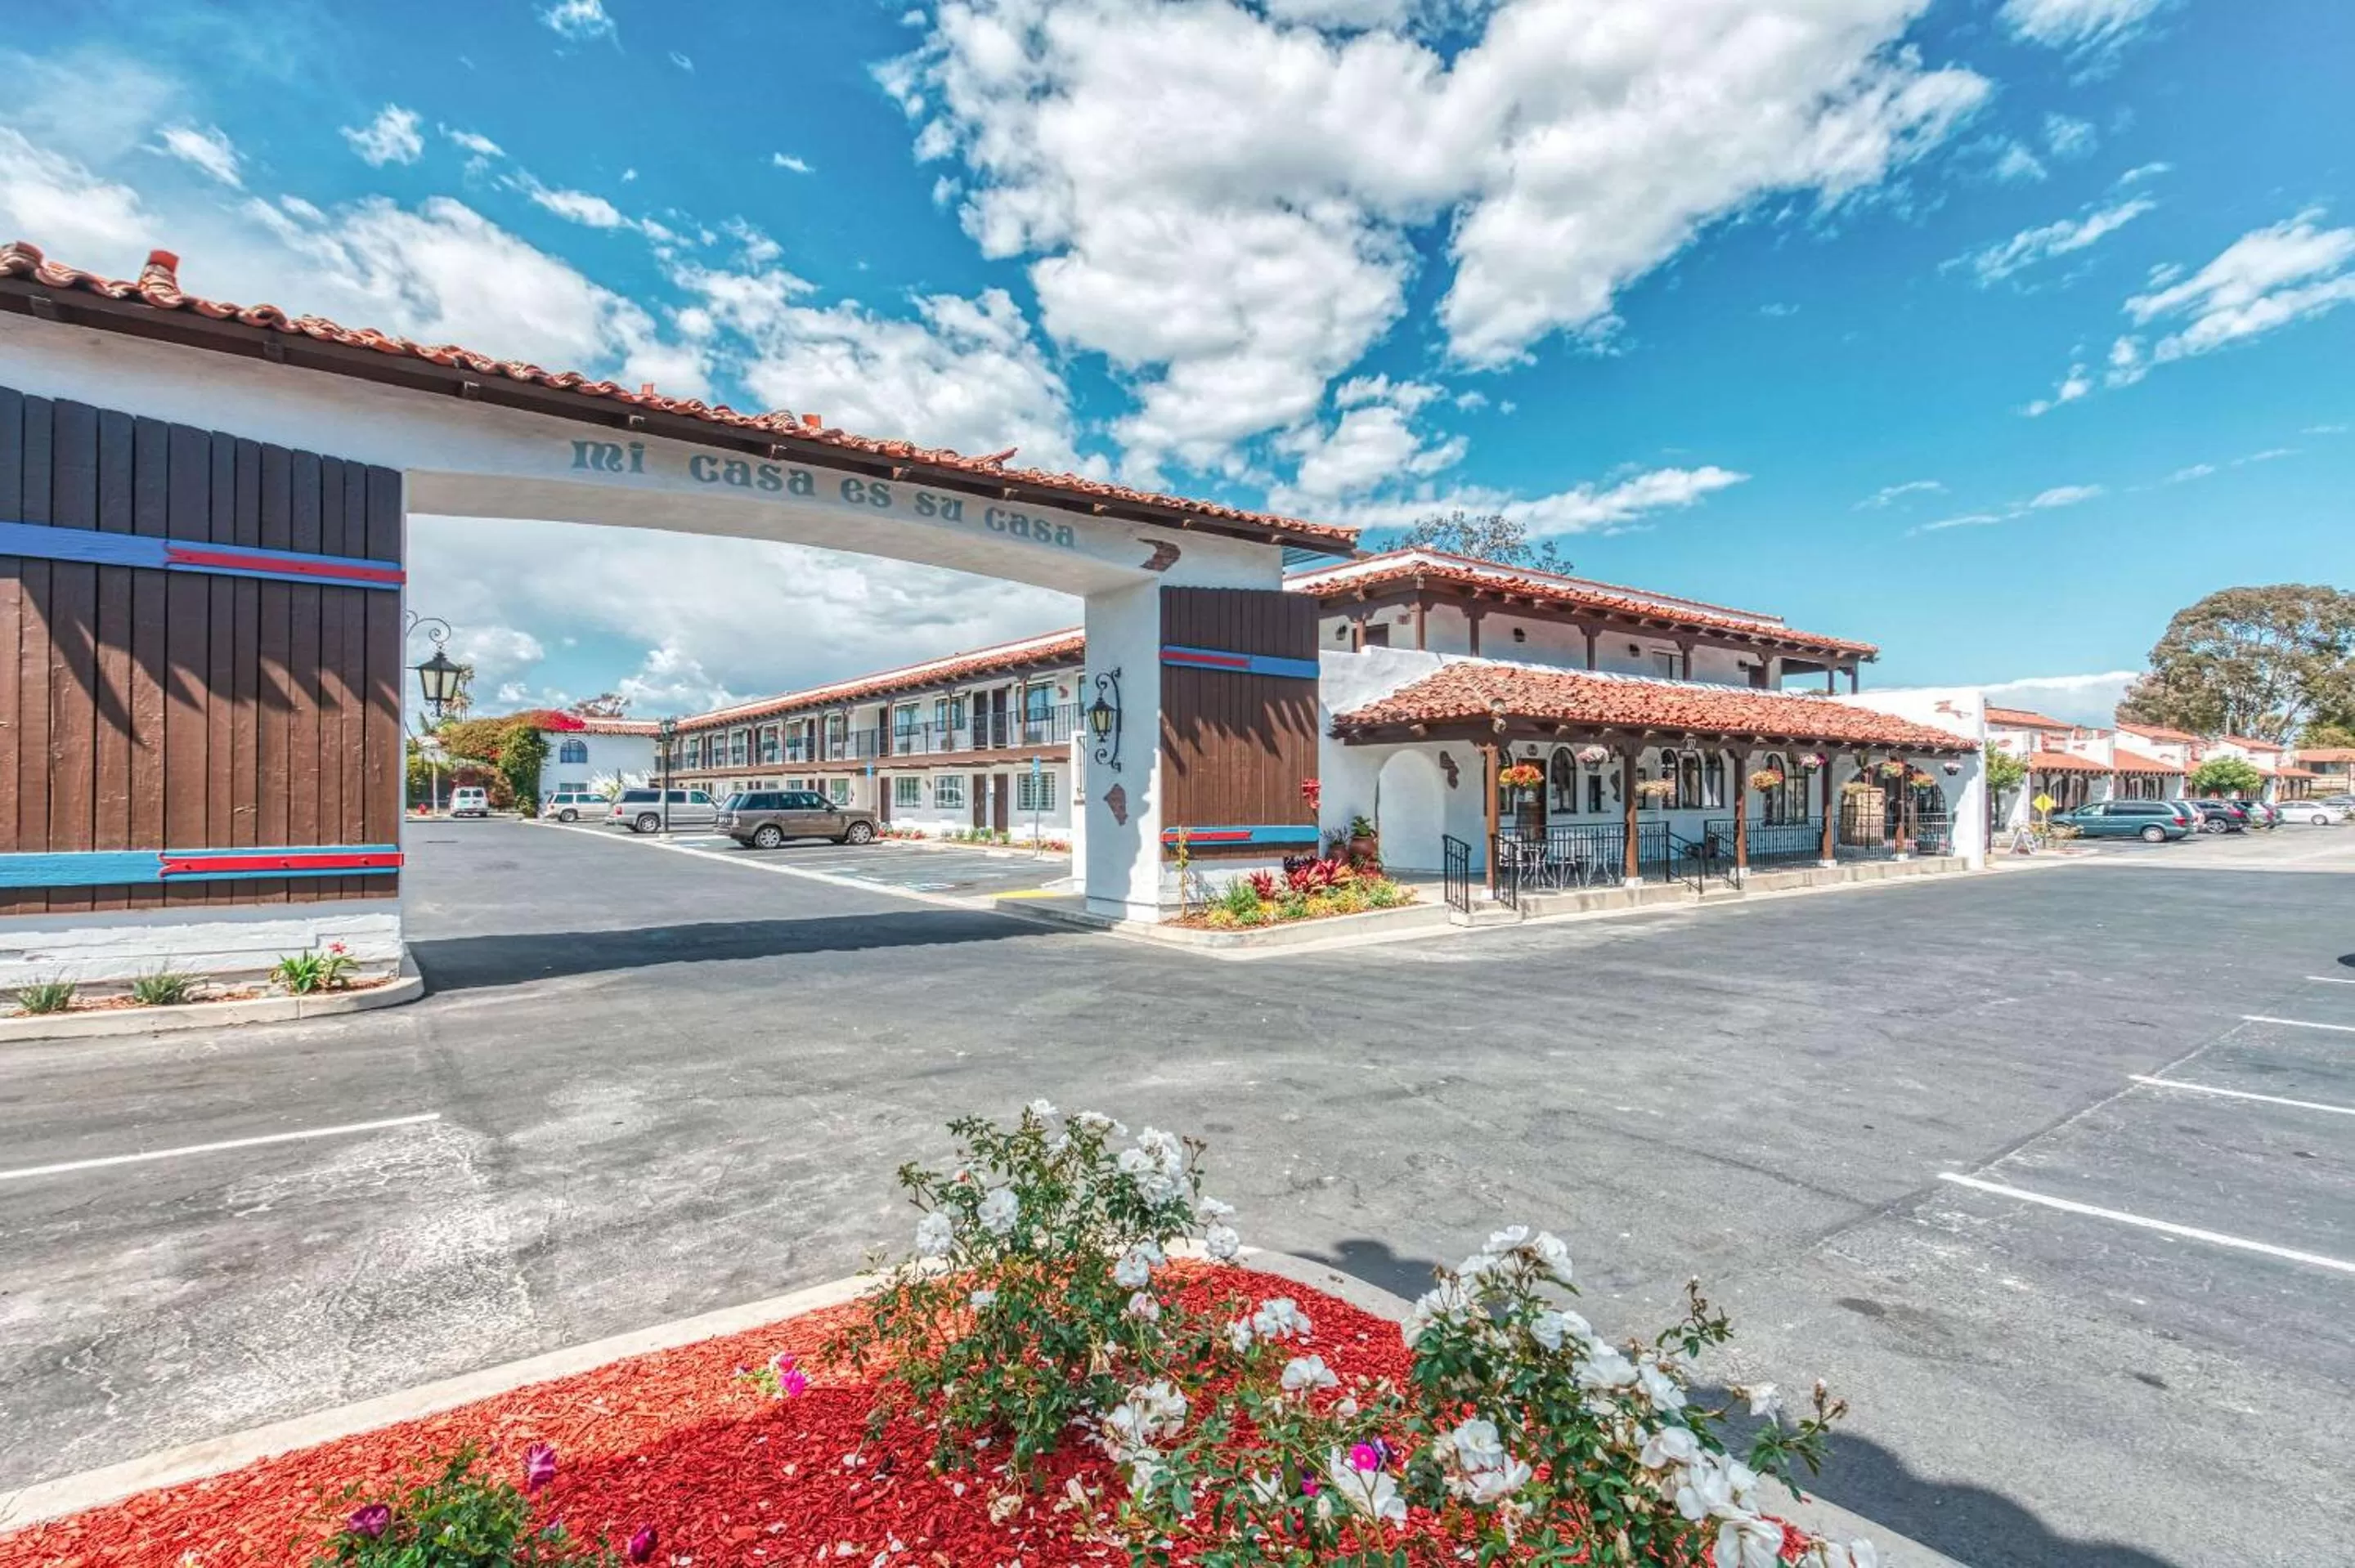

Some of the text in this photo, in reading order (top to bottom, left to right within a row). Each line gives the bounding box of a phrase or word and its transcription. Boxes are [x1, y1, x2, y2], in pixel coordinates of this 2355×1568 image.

[572, 441, 1074, 548] mi casa es su casa
